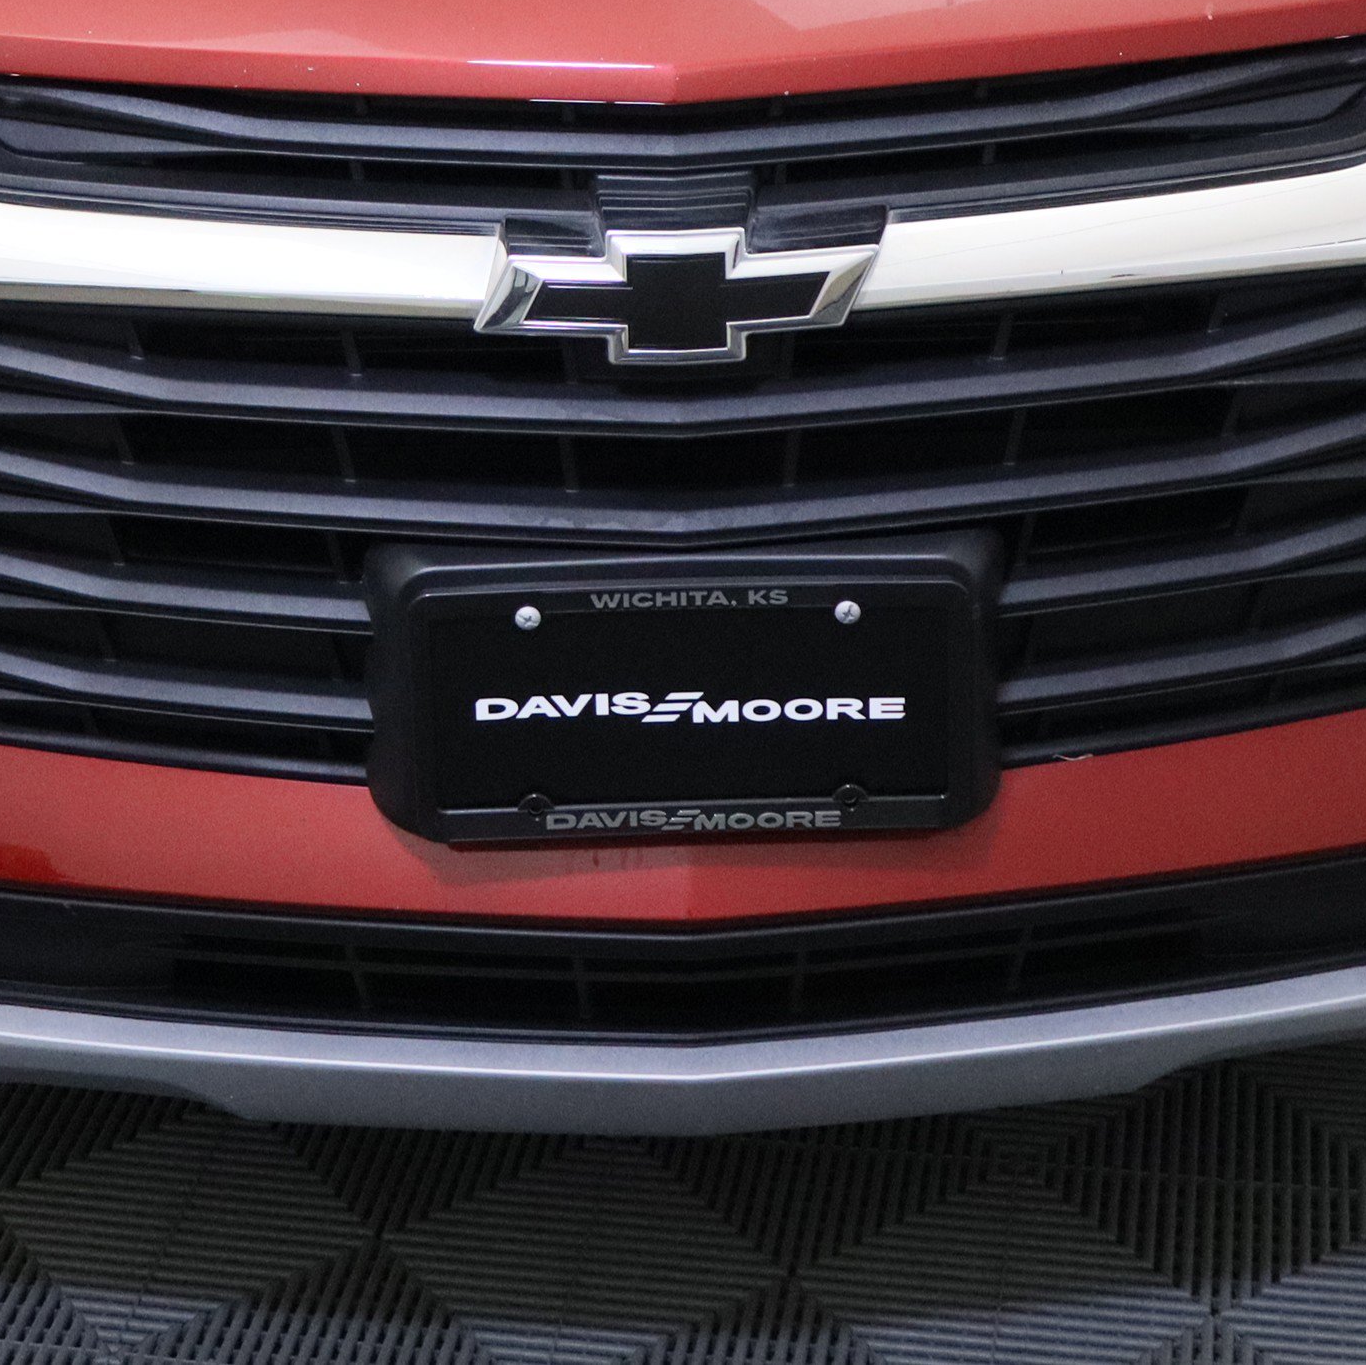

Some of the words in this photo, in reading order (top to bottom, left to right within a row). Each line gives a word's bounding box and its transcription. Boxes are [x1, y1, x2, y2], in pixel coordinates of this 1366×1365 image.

[748, 588, 789, 606] KS
[474, 691, 652, 721] DAVIS
[691, 697, 907, 724] MOORE
[546, 809, 669, 830] DAVIS
[694, 811, 842, 831] MOORE
